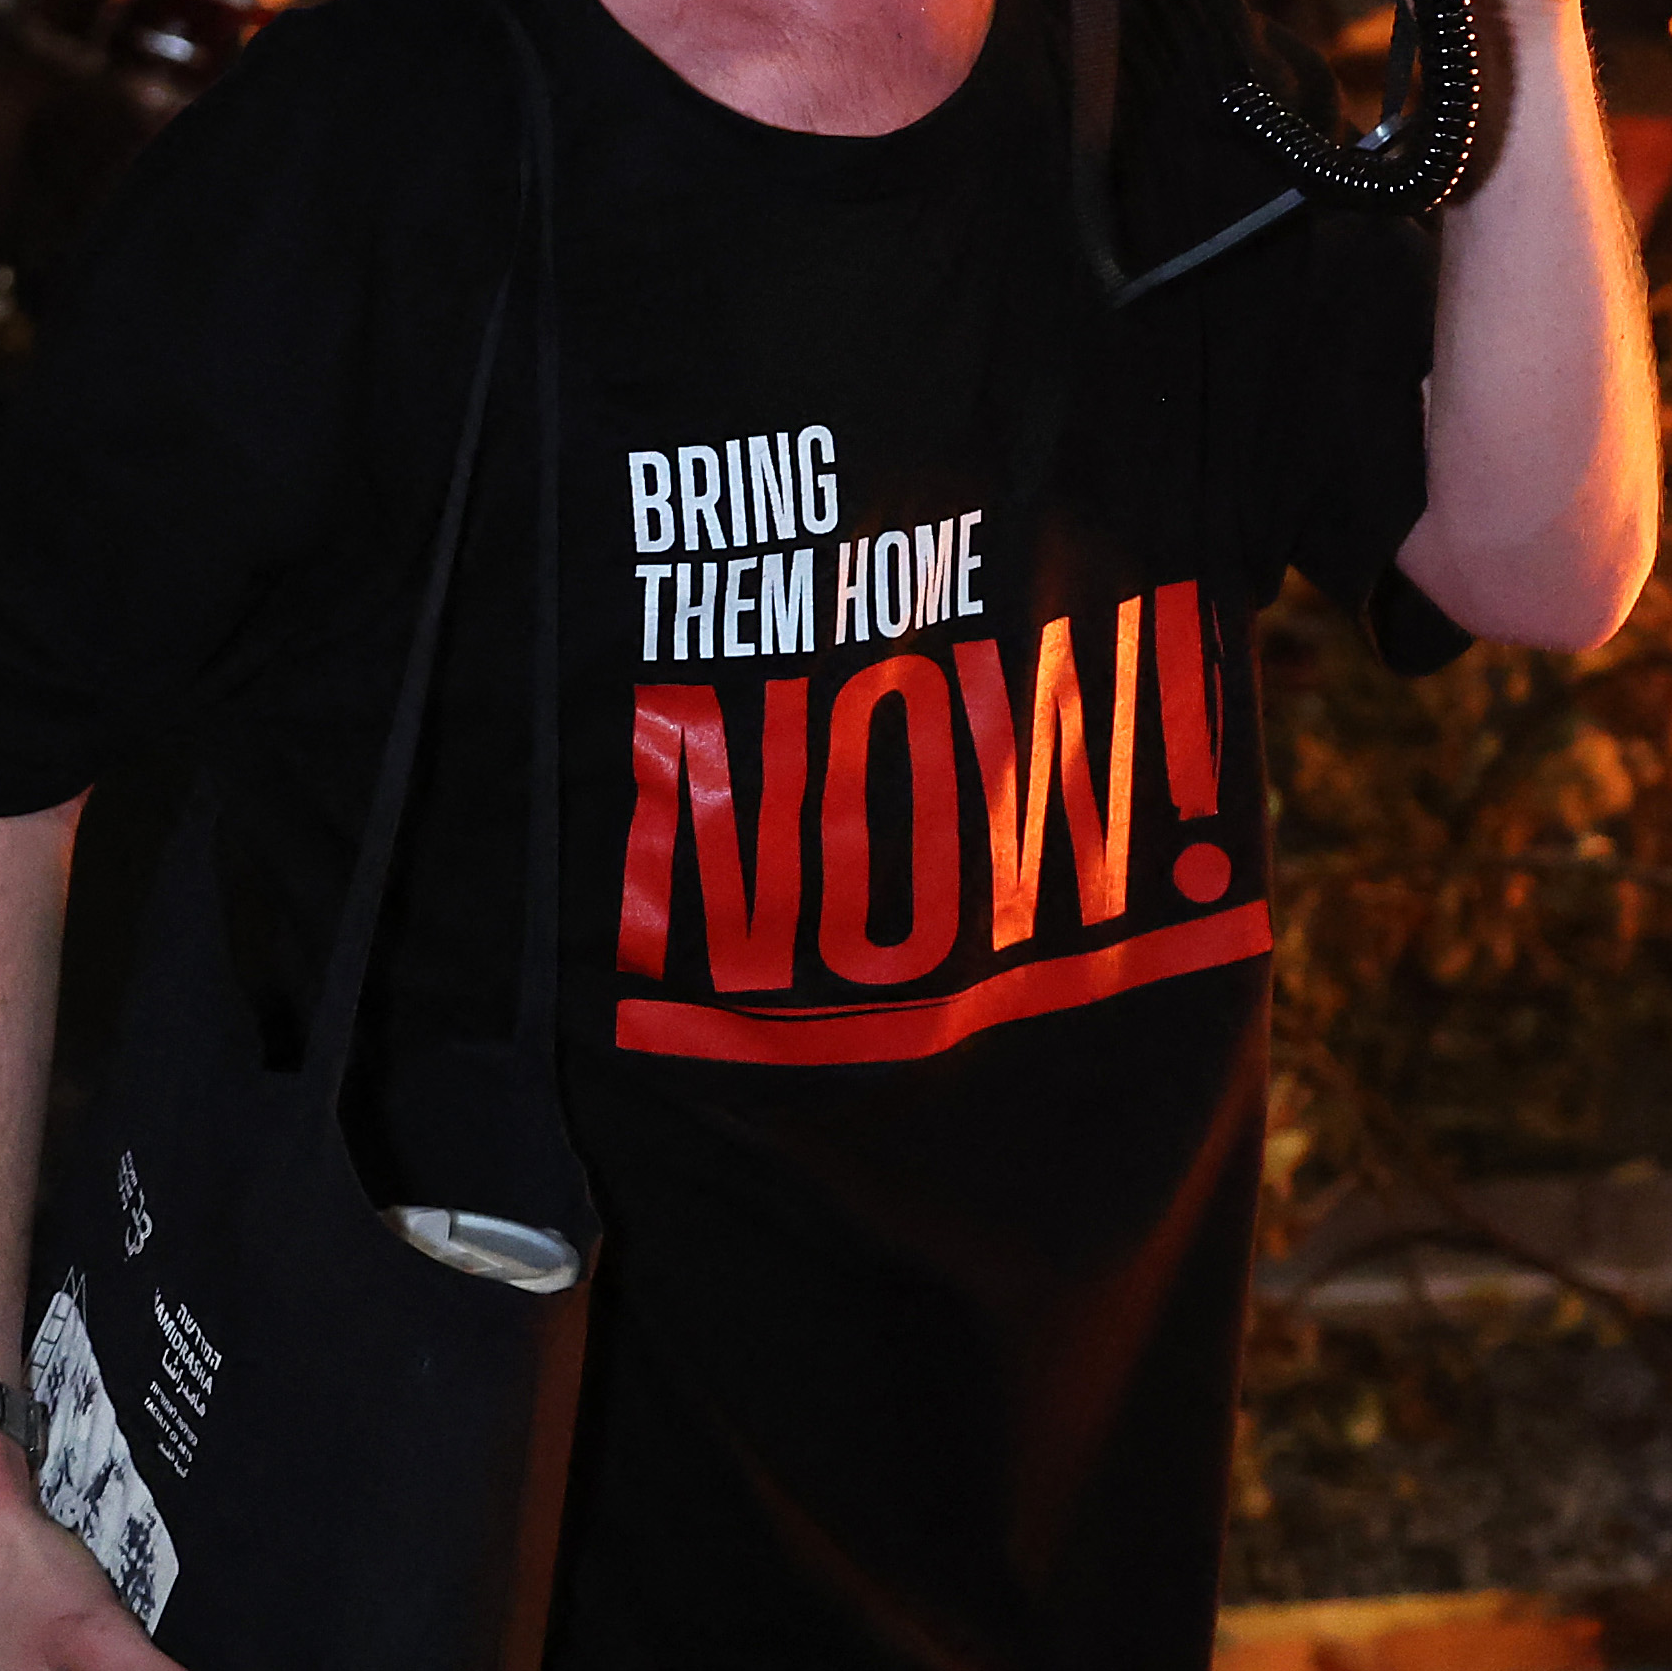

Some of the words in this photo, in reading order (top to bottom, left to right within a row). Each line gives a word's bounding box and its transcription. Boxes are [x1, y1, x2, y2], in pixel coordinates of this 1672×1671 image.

[629, 424, 840, 554] BRING
[634, 548, 815, 662] THEM
[834, 509, 984, 647] HOME
[616, 579, 1232, 993] NOW!
